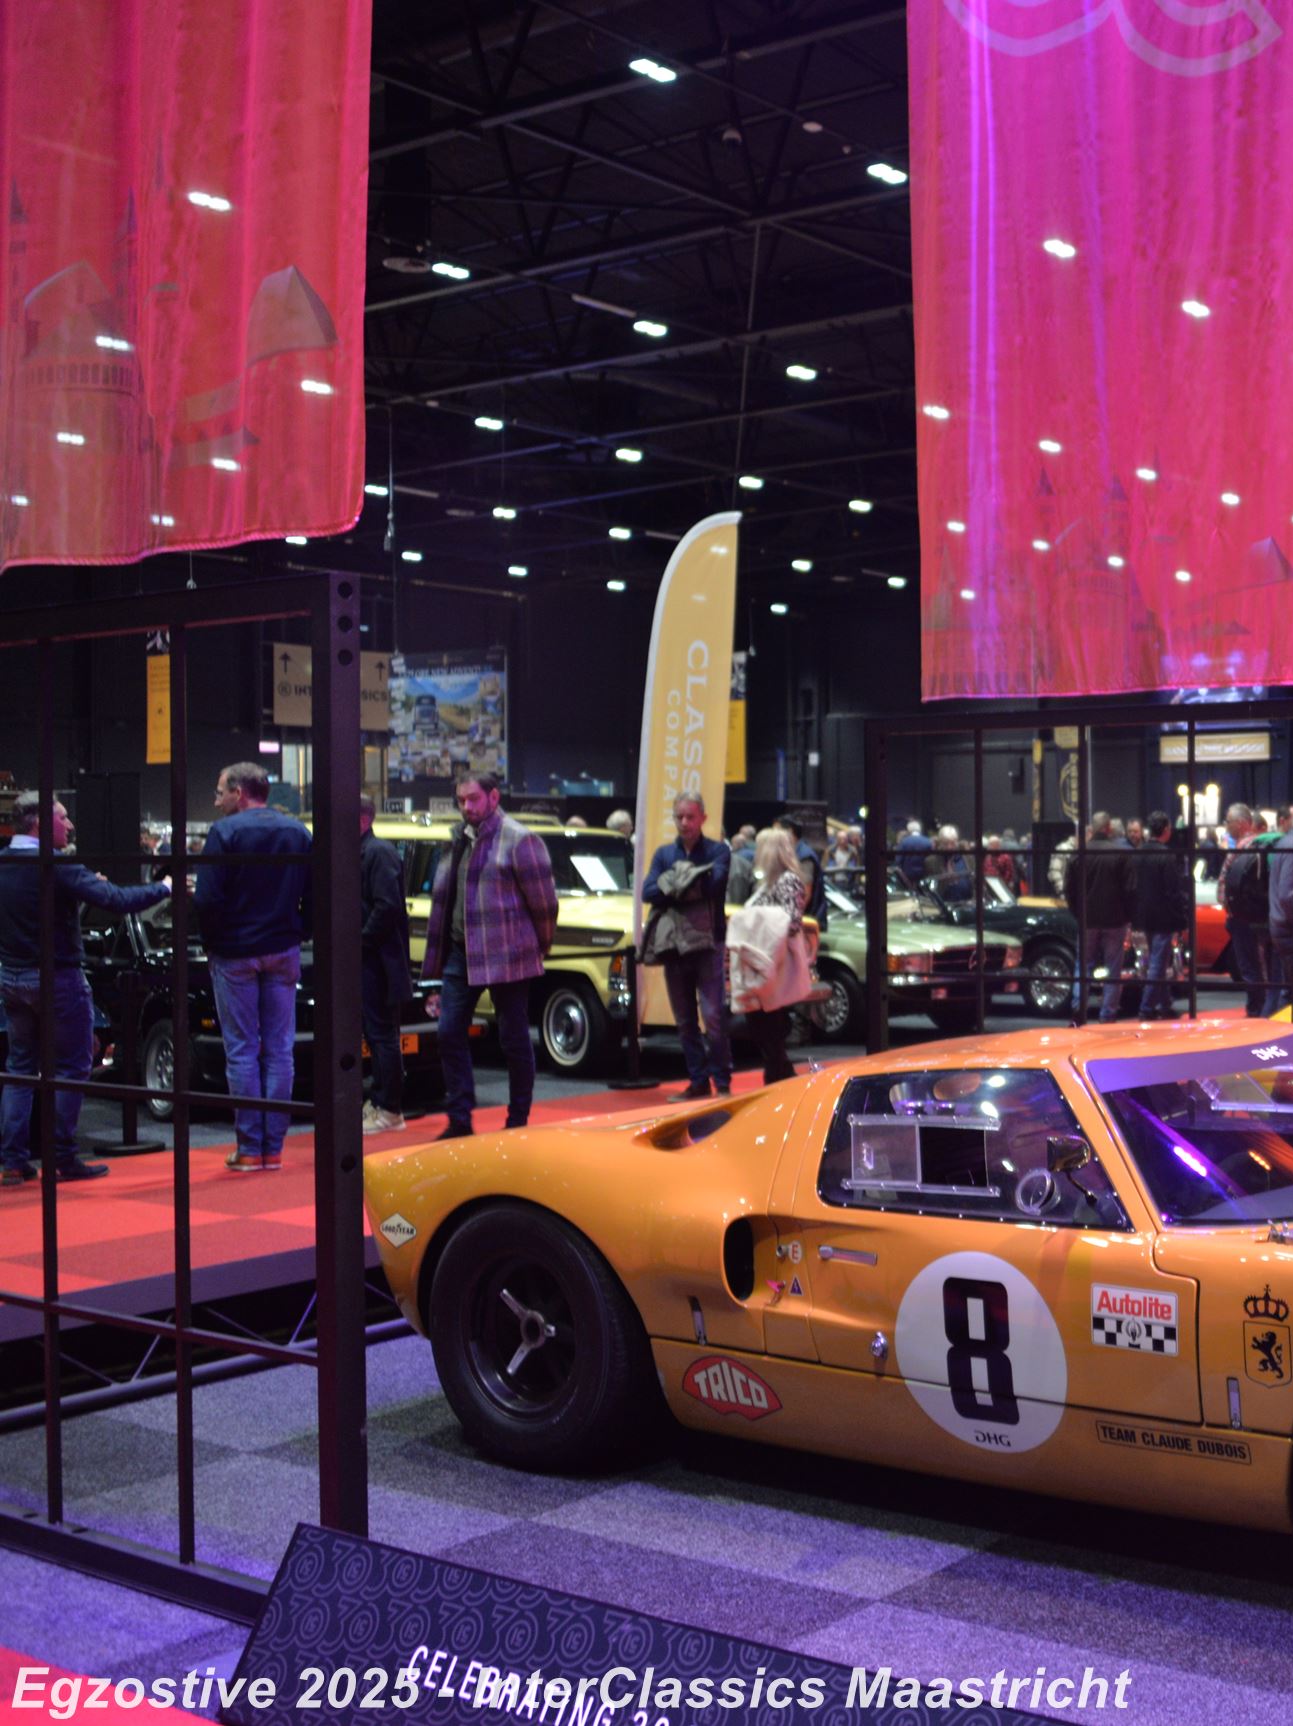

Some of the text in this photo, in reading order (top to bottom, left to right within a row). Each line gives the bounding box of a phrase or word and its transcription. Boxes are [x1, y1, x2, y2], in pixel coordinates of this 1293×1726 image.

[1097, 1289, 1172, 1321] Autolite
[943, 1276, 1019, 1425] 8
[693, 1361, 769, 1409] TRICO
[1101, 1425, 1247, 1460] TEAM CLAUDE DUBOIS
[404, 1644, 616, 1726] CELEBRATING
